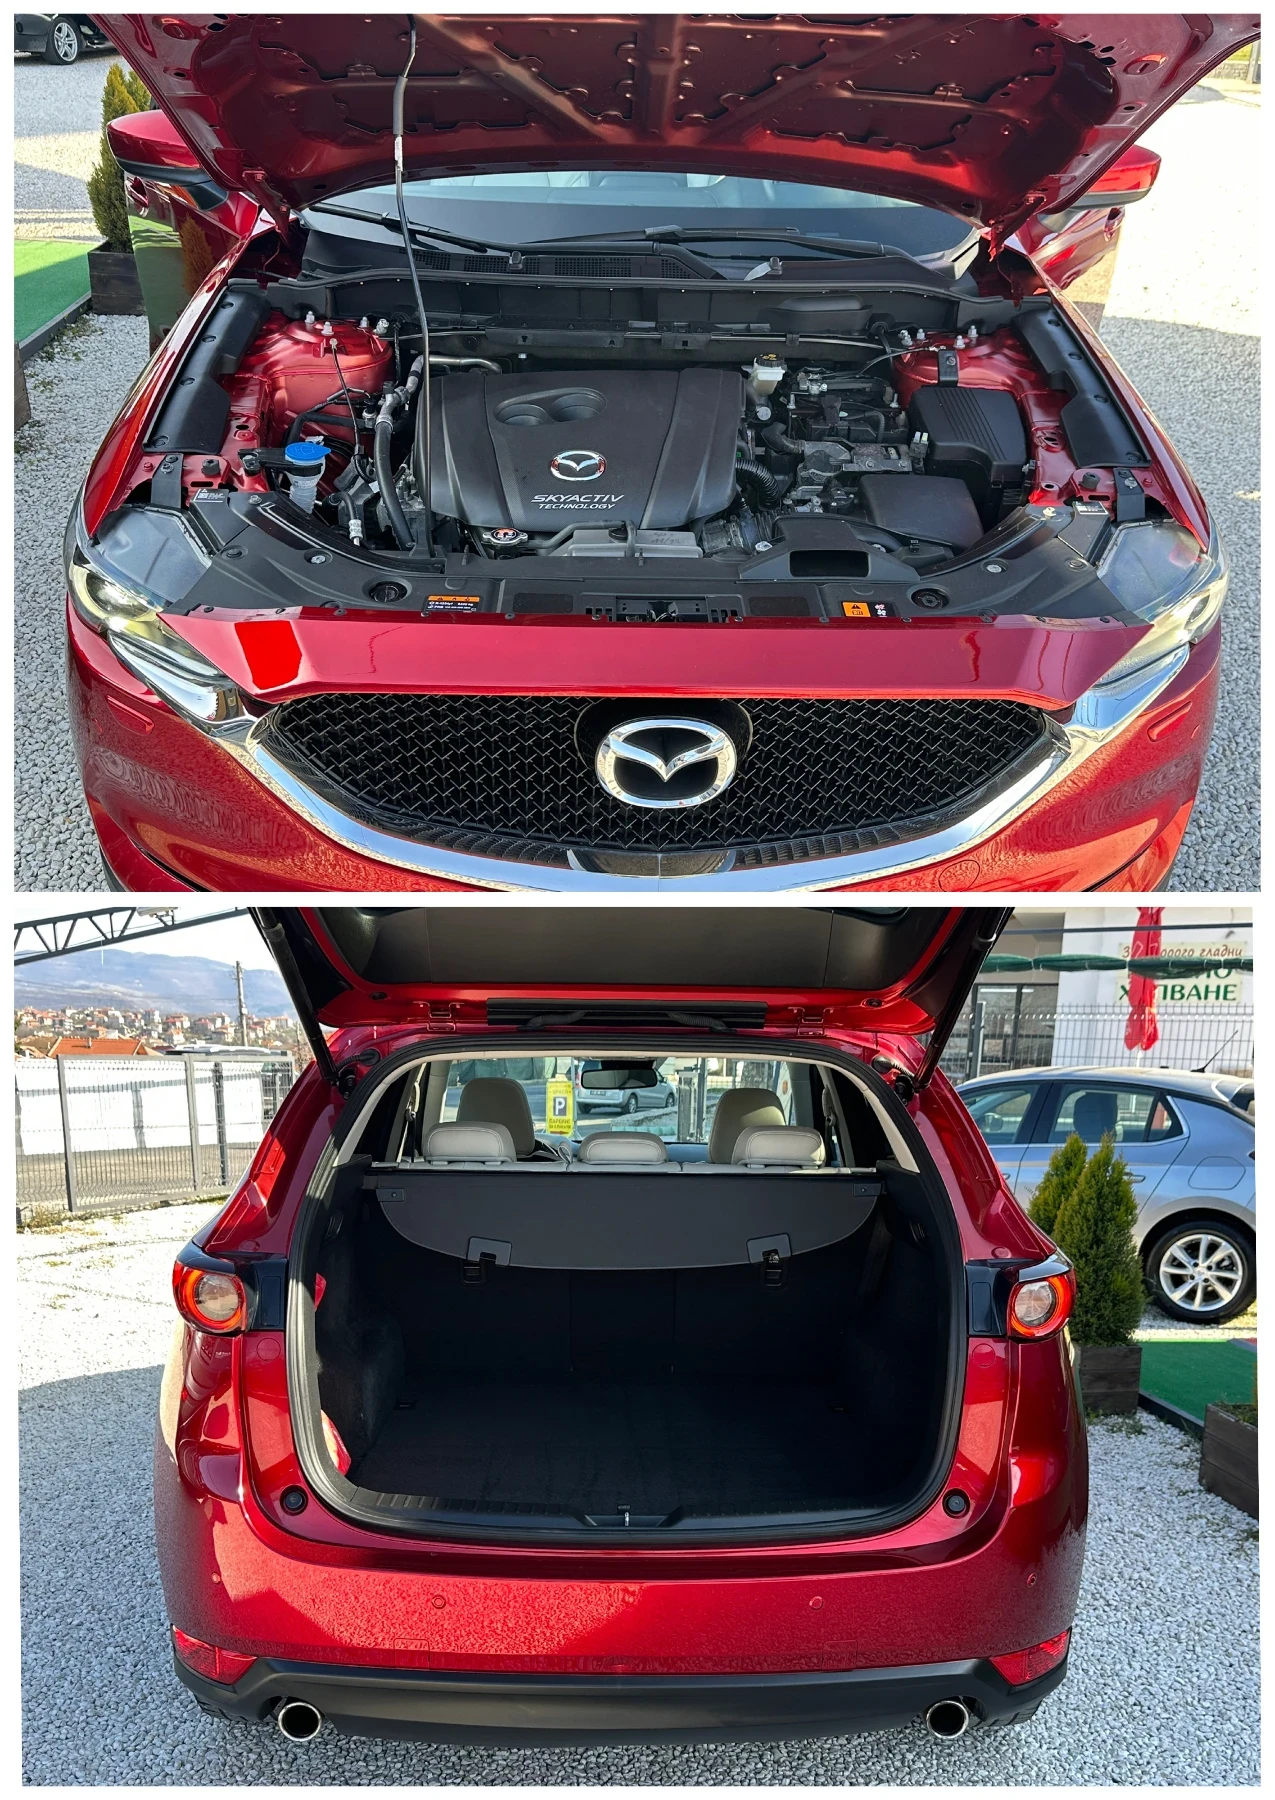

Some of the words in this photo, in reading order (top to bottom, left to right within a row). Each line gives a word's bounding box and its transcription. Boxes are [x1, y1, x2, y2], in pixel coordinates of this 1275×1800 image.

[531, 494, 625, 503] SKYACTIV
[1199, 944, 1243, 958] гладни
[1119, 984, 1238, 1001] ХПВАНЕ
[555, 1097, 566, 1116] P
